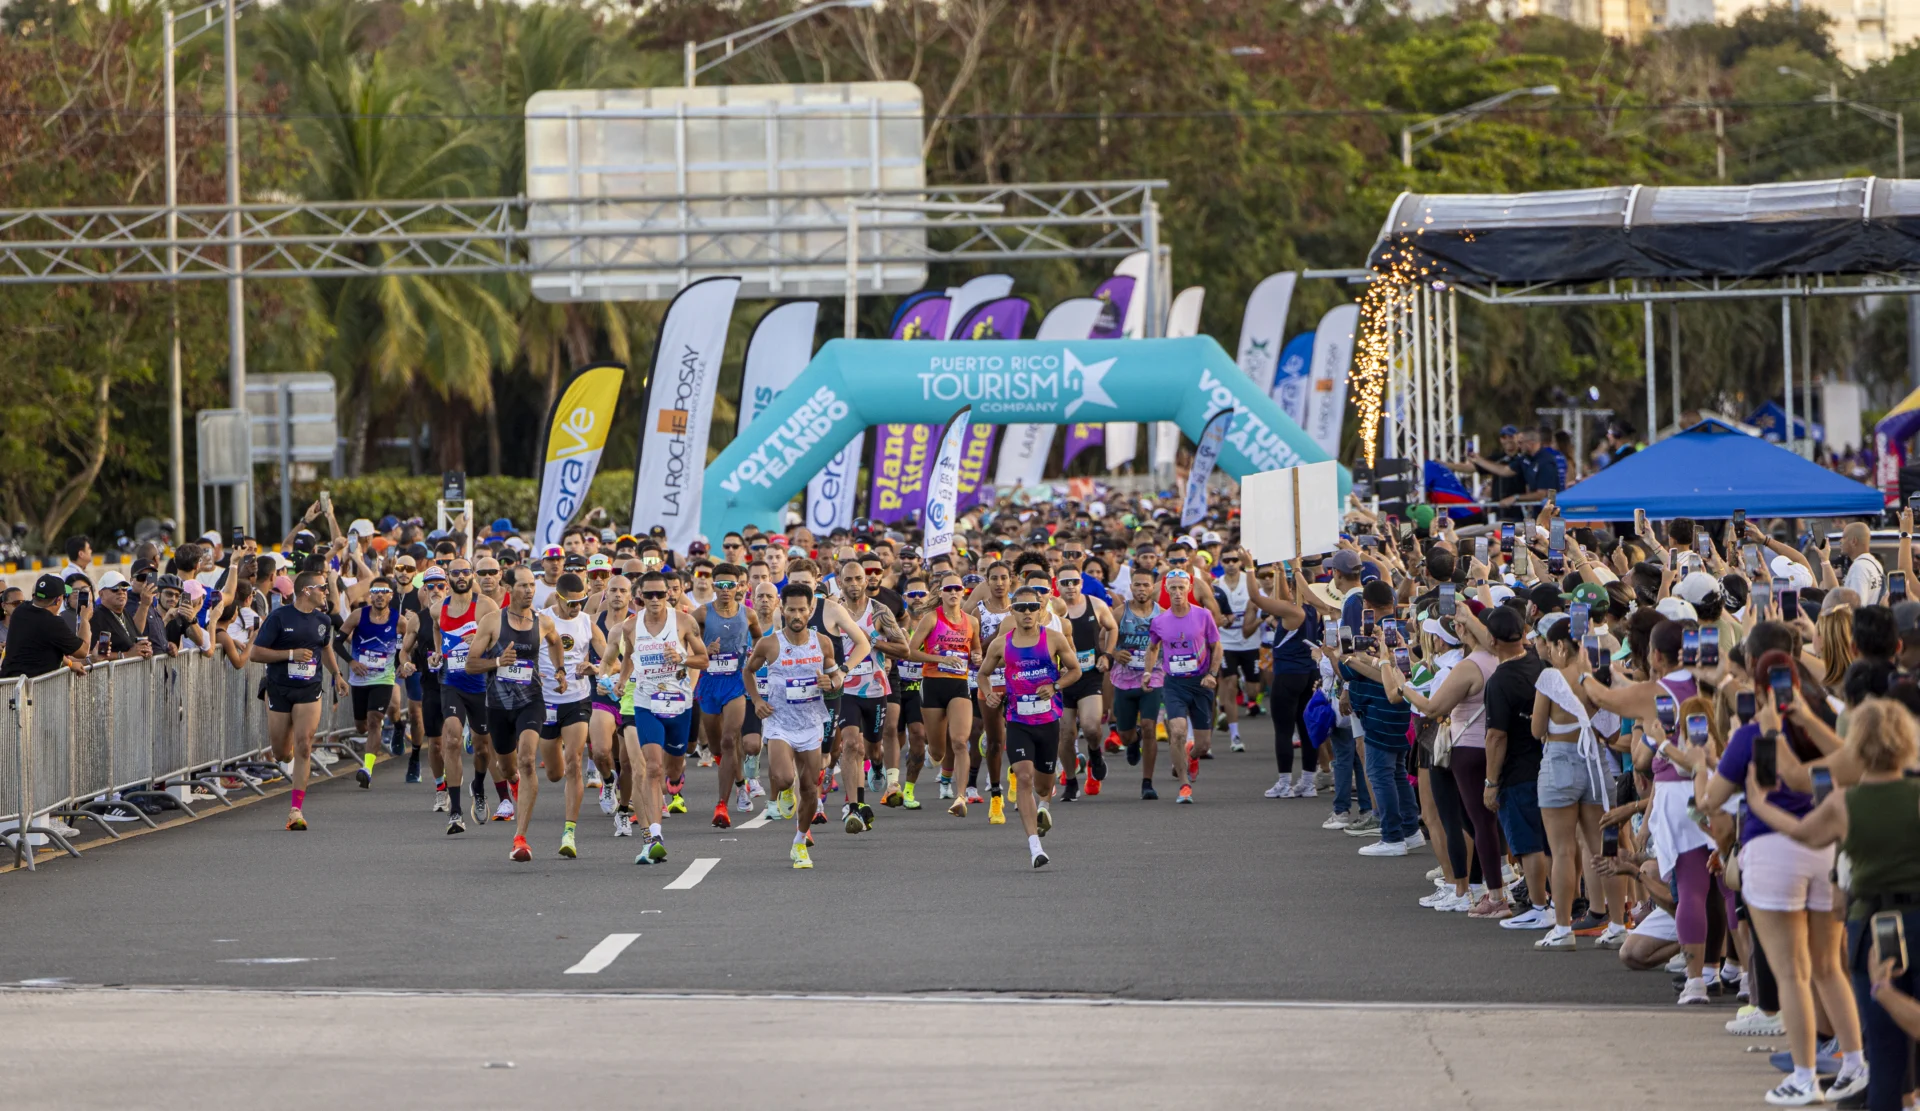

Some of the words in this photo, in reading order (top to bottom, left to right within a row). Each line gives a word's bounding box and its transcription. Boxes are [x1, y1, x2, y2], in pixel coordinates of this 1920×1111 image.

[673, 344, 700, 413] POSAY
[917, 372, 1059, 401] TOURISM
[930, 356, 1004, 371] PUERTO
[1011, 355, 1060, 371] RICO
[980, 402, 1058, 413] COMPANY
[1198, 368, 1249, 416] VOY
[664, 414, 689, 489] ROCHE
[720, 441, 769, 493] VOY
[764, 385, 836, 451] TURIS
[751, 400, 849, 489] TEANDO
[661, 490, 682, 518] LA
